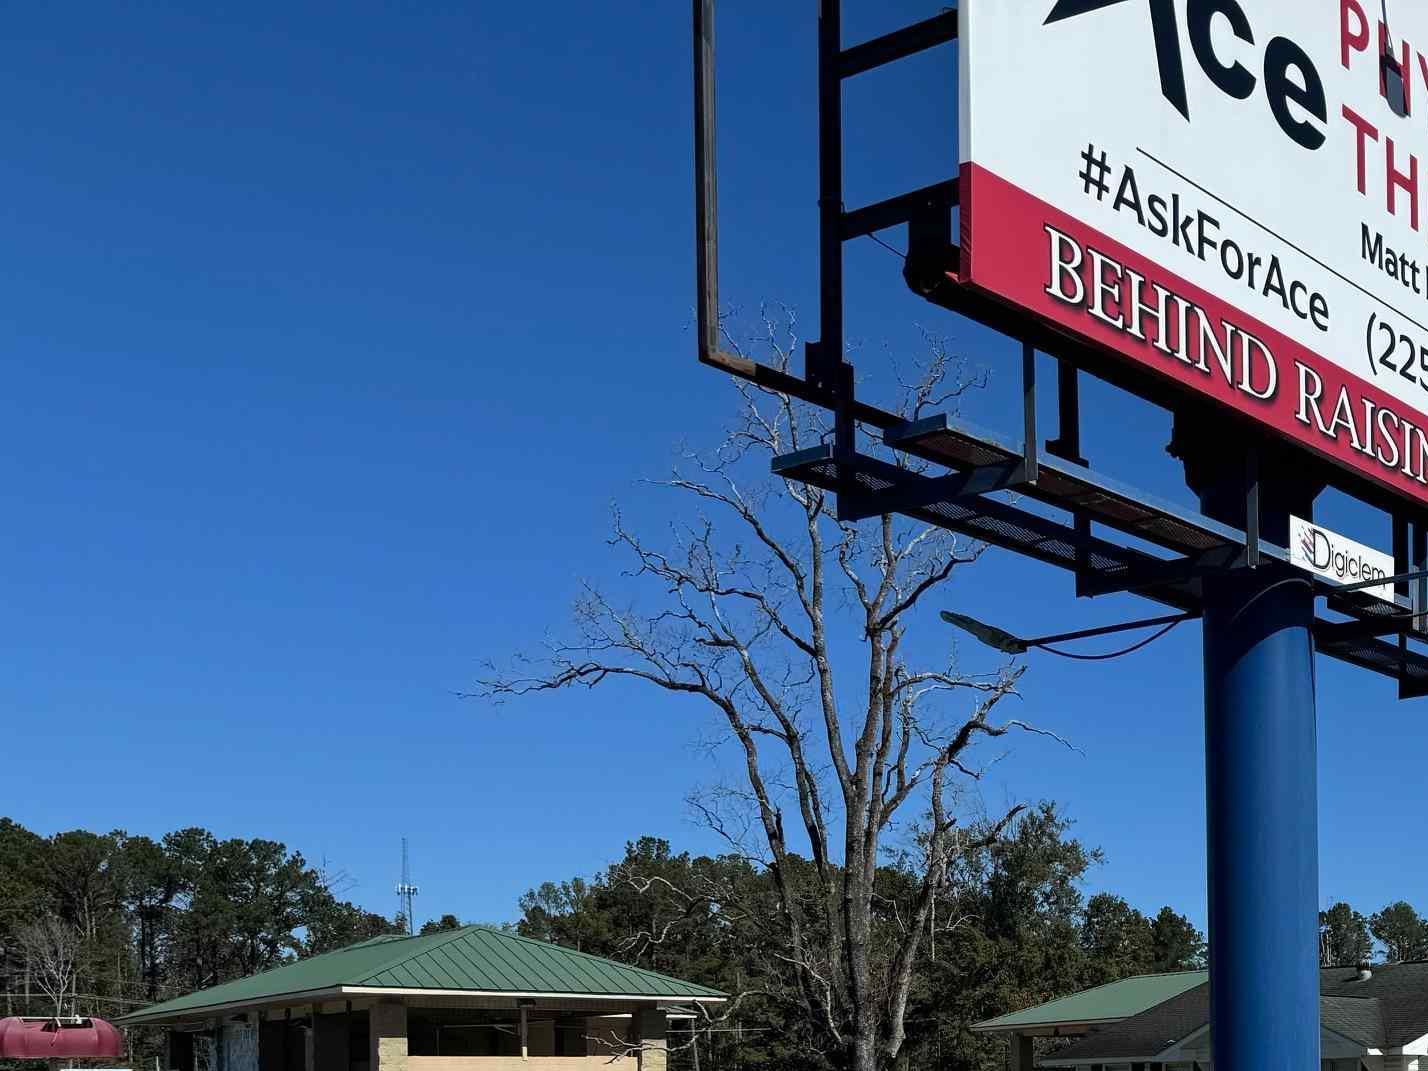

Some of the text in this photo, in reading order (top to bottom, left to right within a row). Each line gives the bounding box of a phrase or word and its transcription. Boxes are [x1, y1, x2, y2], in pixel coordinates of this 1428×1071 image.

[1079, 143, 1329, 332] #AskForAce
[1361, 221, 1420, 294] Matt
[1044, 225, 1277, 400] BEHIND
[1313, 528, 1386, 589] Digiclem
